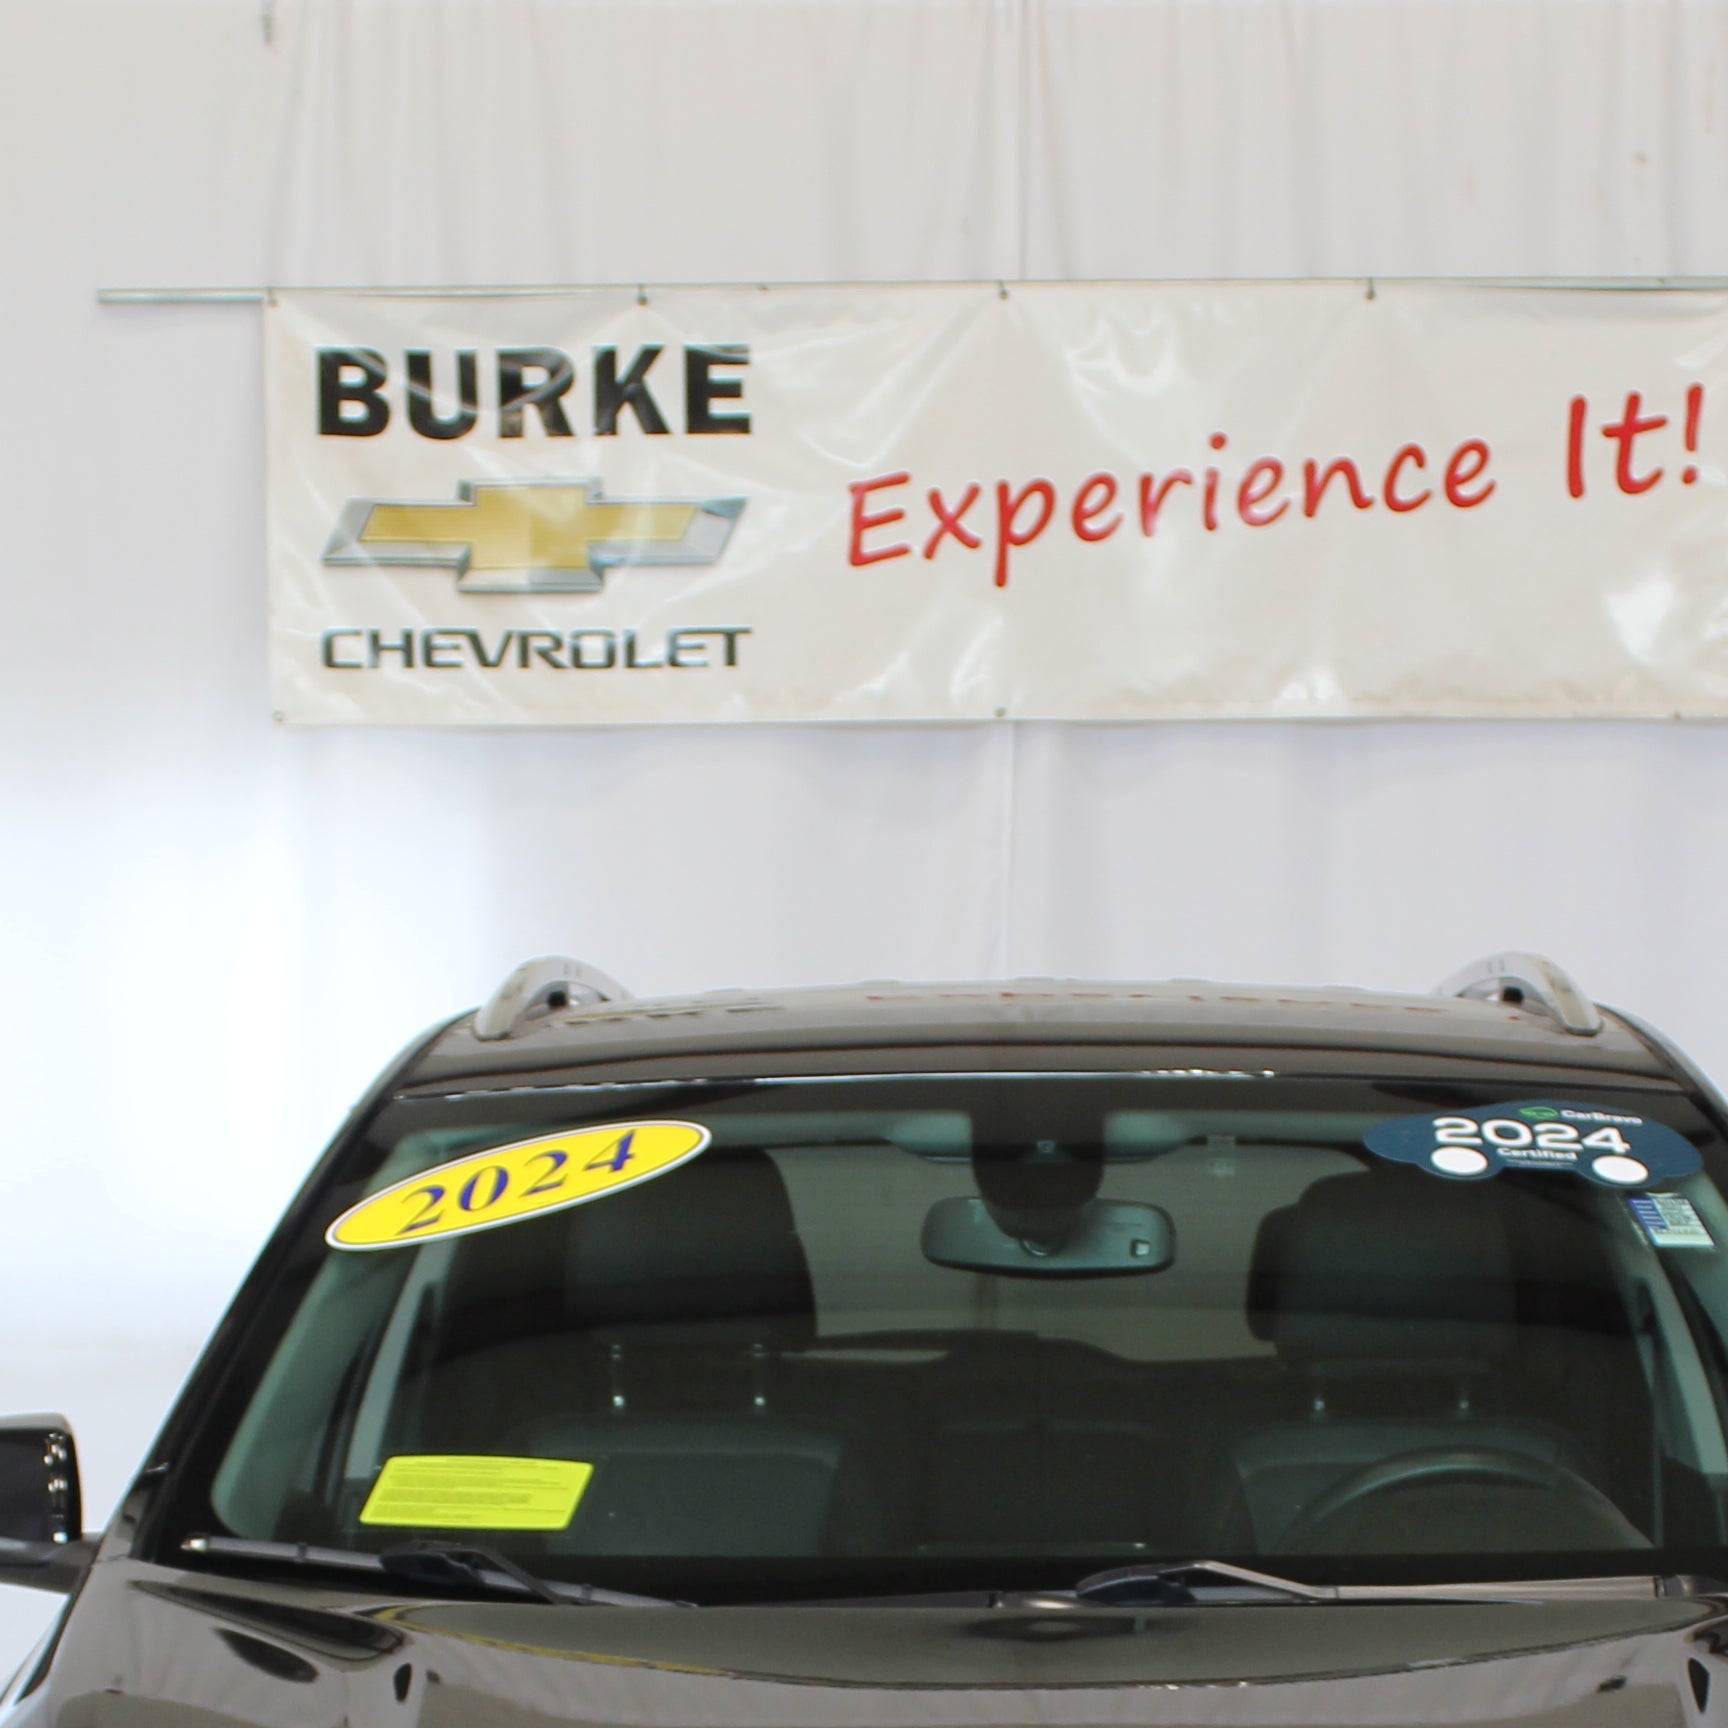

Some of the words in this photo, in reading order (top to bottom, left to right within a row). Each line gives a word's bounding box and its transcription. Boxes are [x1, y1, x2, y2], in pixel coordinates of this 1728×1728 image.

[316, 345, 752, 440] BURKE
[847, 432, 1499, 589] Experience
[1564, 383, 1706, 499] It!
[322, 626, 753, 670] CHEVROLET
[396, 1129, 636, 1236] 2024
[1433, 1117, 1631, 1154] 2024
